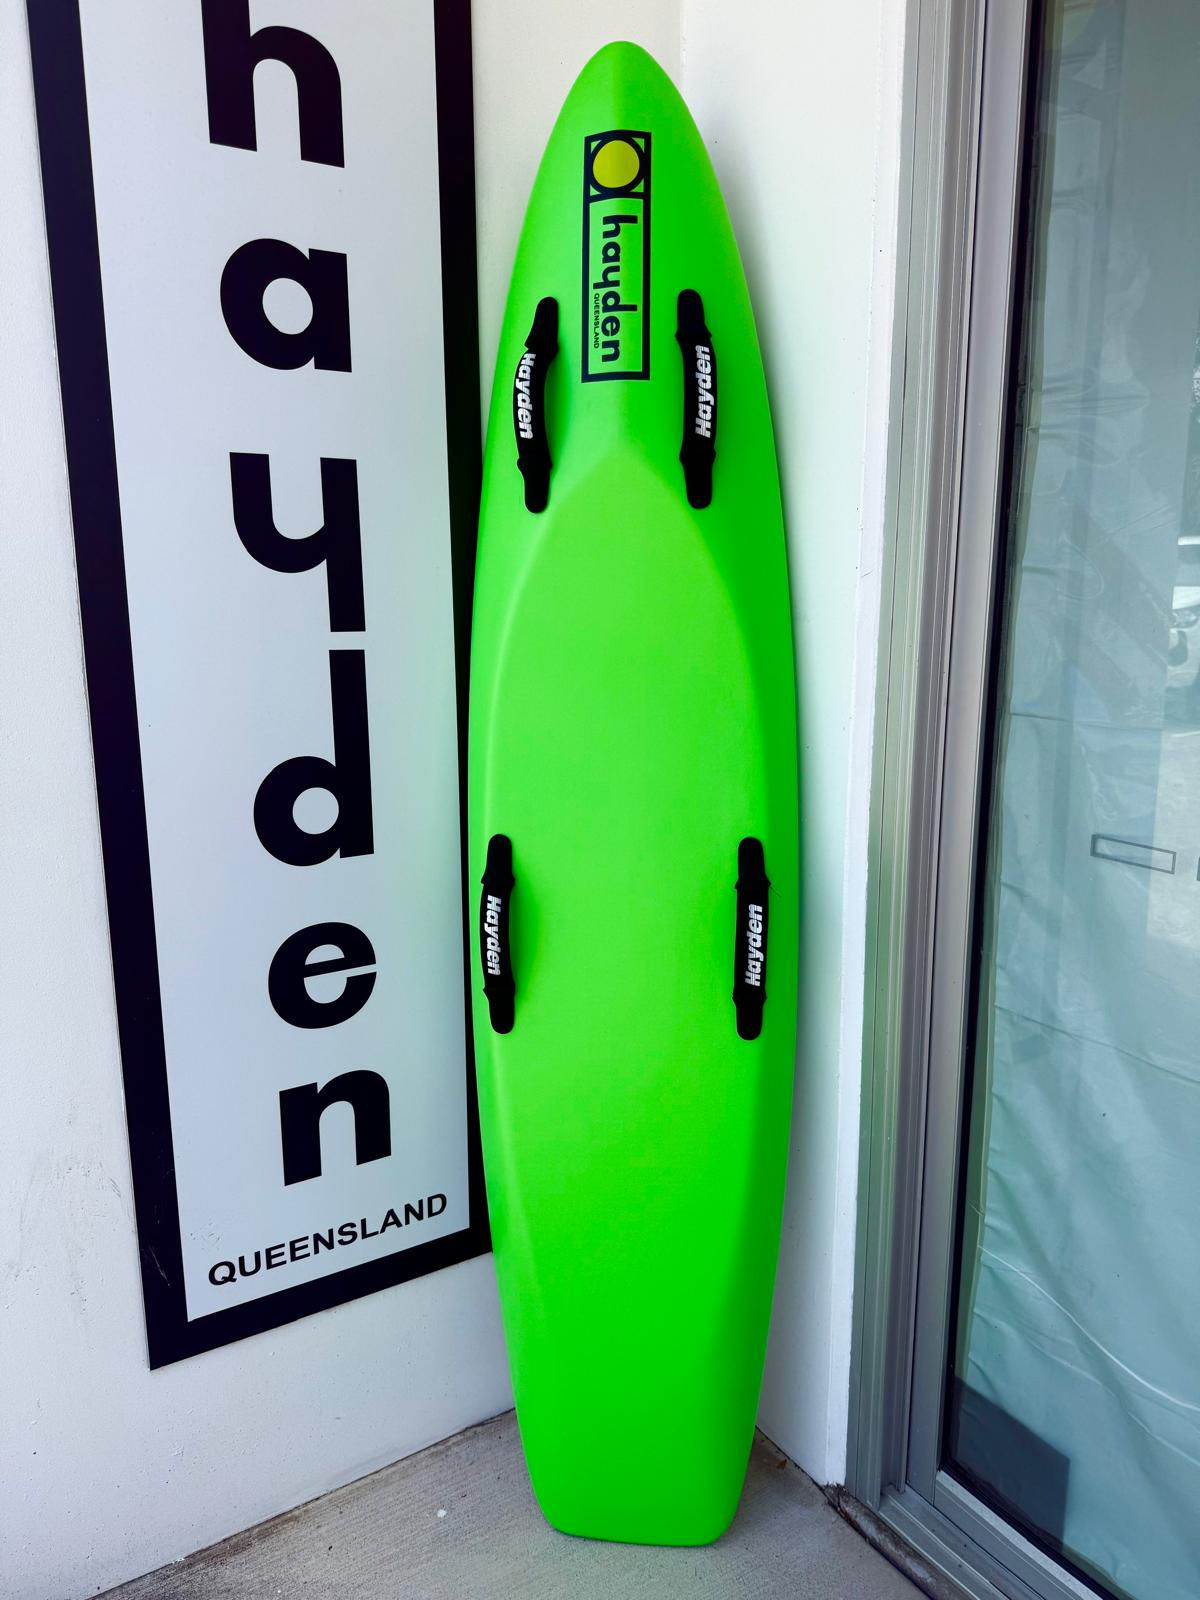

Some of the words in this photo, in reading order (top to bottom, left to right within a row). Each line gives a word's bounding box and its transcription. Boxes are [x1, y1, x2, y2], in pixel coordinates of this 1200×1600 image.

[593, 215, 638, 362] hayden
[515, 353, 536, 440] Hayden
[695, 345, 715, 438] Hayden
[201, 0, 391, 1186] hayden
[484, 894, 502, 976] Hayden
[745, 904, 764, 987] Hayden
[208, 1193, 448, 1286] QUEENSLAND
